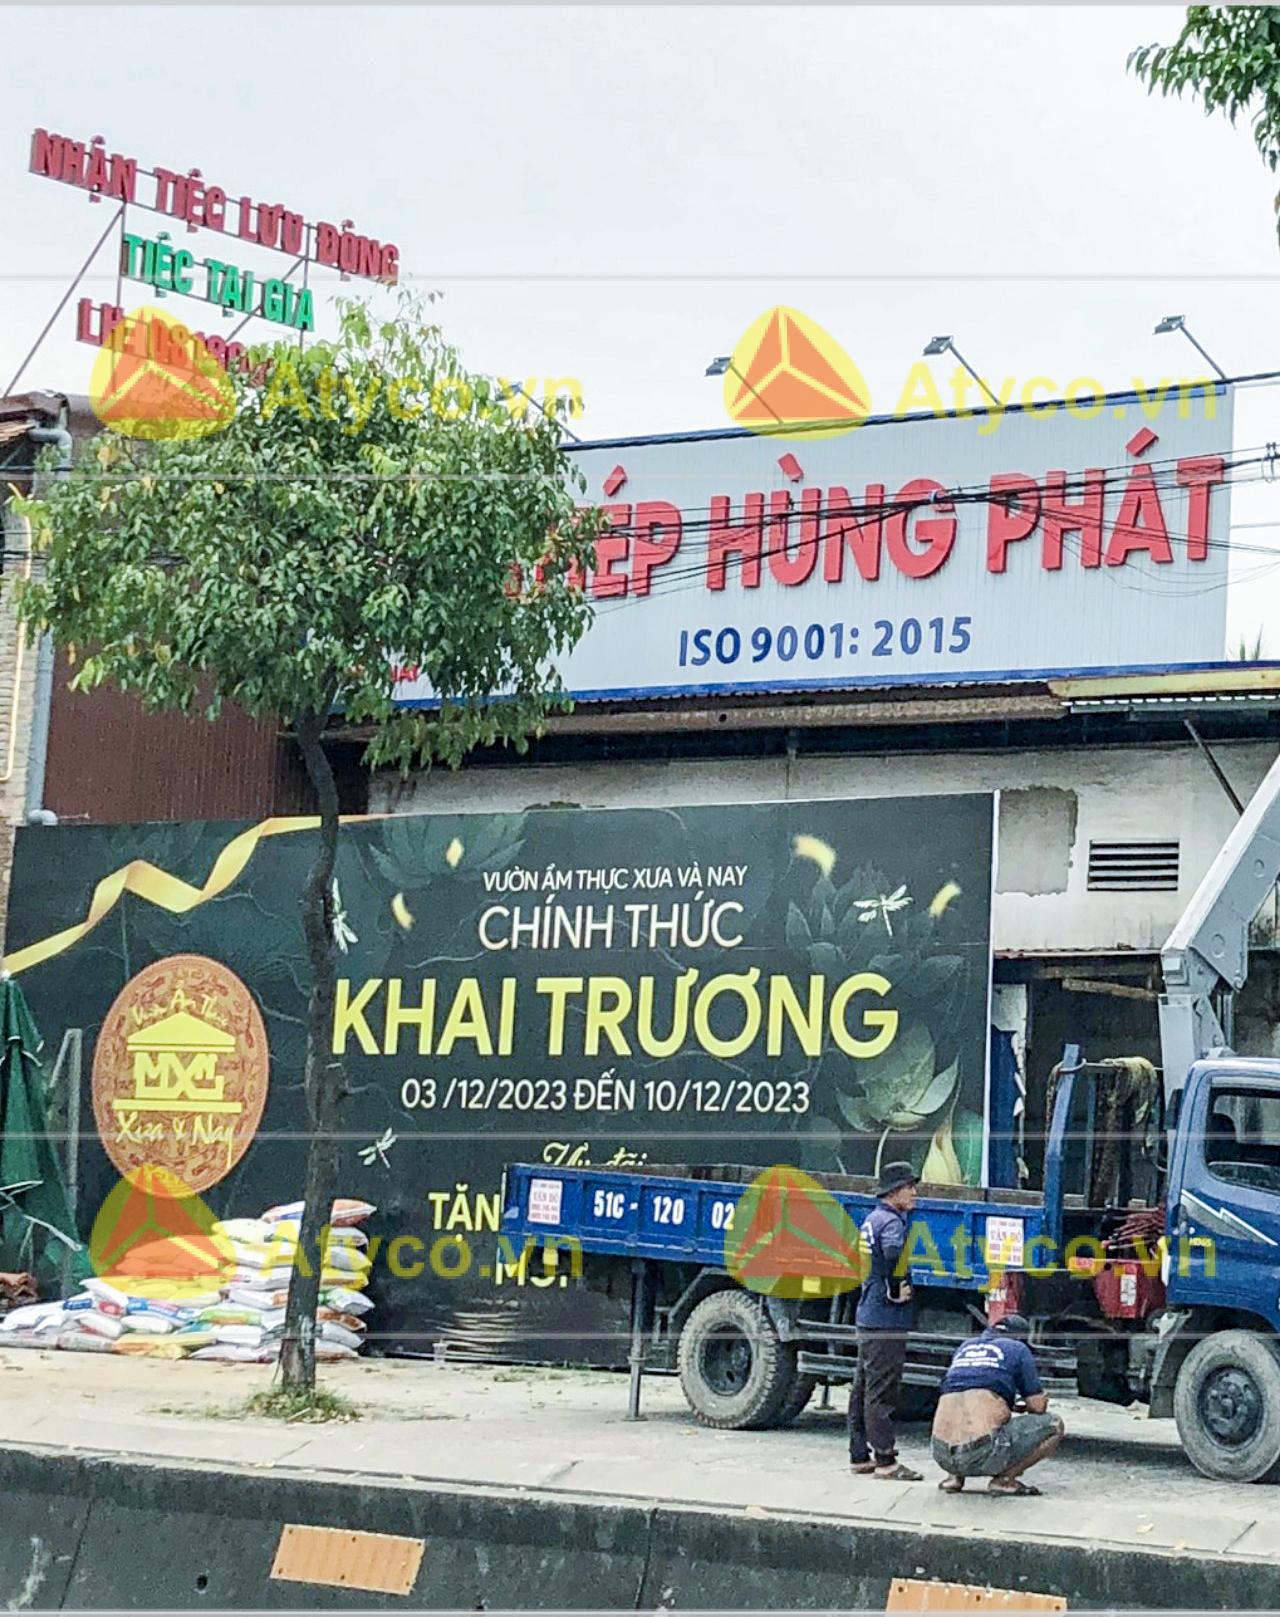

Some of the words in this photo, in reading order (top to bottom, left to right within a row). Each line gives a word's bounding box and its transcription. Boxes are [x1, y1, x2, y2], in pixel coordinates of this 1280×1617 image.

[29, 128, 137, 203] NHẬN
[153, 167, 227, 233] TIỆC
[238, 197, 304, 255] LƯU
[315, 218, 400, 286] ĐỘNG
[123, 231, 194, 298] TIỆC
[204, 257, 255, 318] TẠI
[263, 279, 315, 332] GIA
[706, 452, 958, 591] HÙNG
[987, 427, 1226, 574] PHÁT
[679, 627, 741, 666] ISO
[751, 621, 860, 663] 9001:
[872, 616, 973, 657] 2015
[483, 866, 539, 892] VƯỜN
[541, 863, 573, 891] ẨM
[576, 868, 629, 895] THỰC
[633, 867, 674, 889] XƯA
[677, 861, 703, 888] VÀ
[706, 865, 748, 887] NAY
[478, 894, 614, 951] CHÍNH
[624, 890, 744, 949] THỨC
[332, 976, 514, 1057] KHAI
[536, 965, 899, 1059] TRƯƠNG
[573, 1066, 636, 1112] ĐẾN
[644, 1079, 810, 1114] 10/12/2023
[593, 1189, 625, 1220] 51C
[653, 1195, 685, 1225] 120
[712, 1201, 736, 1230] 02
